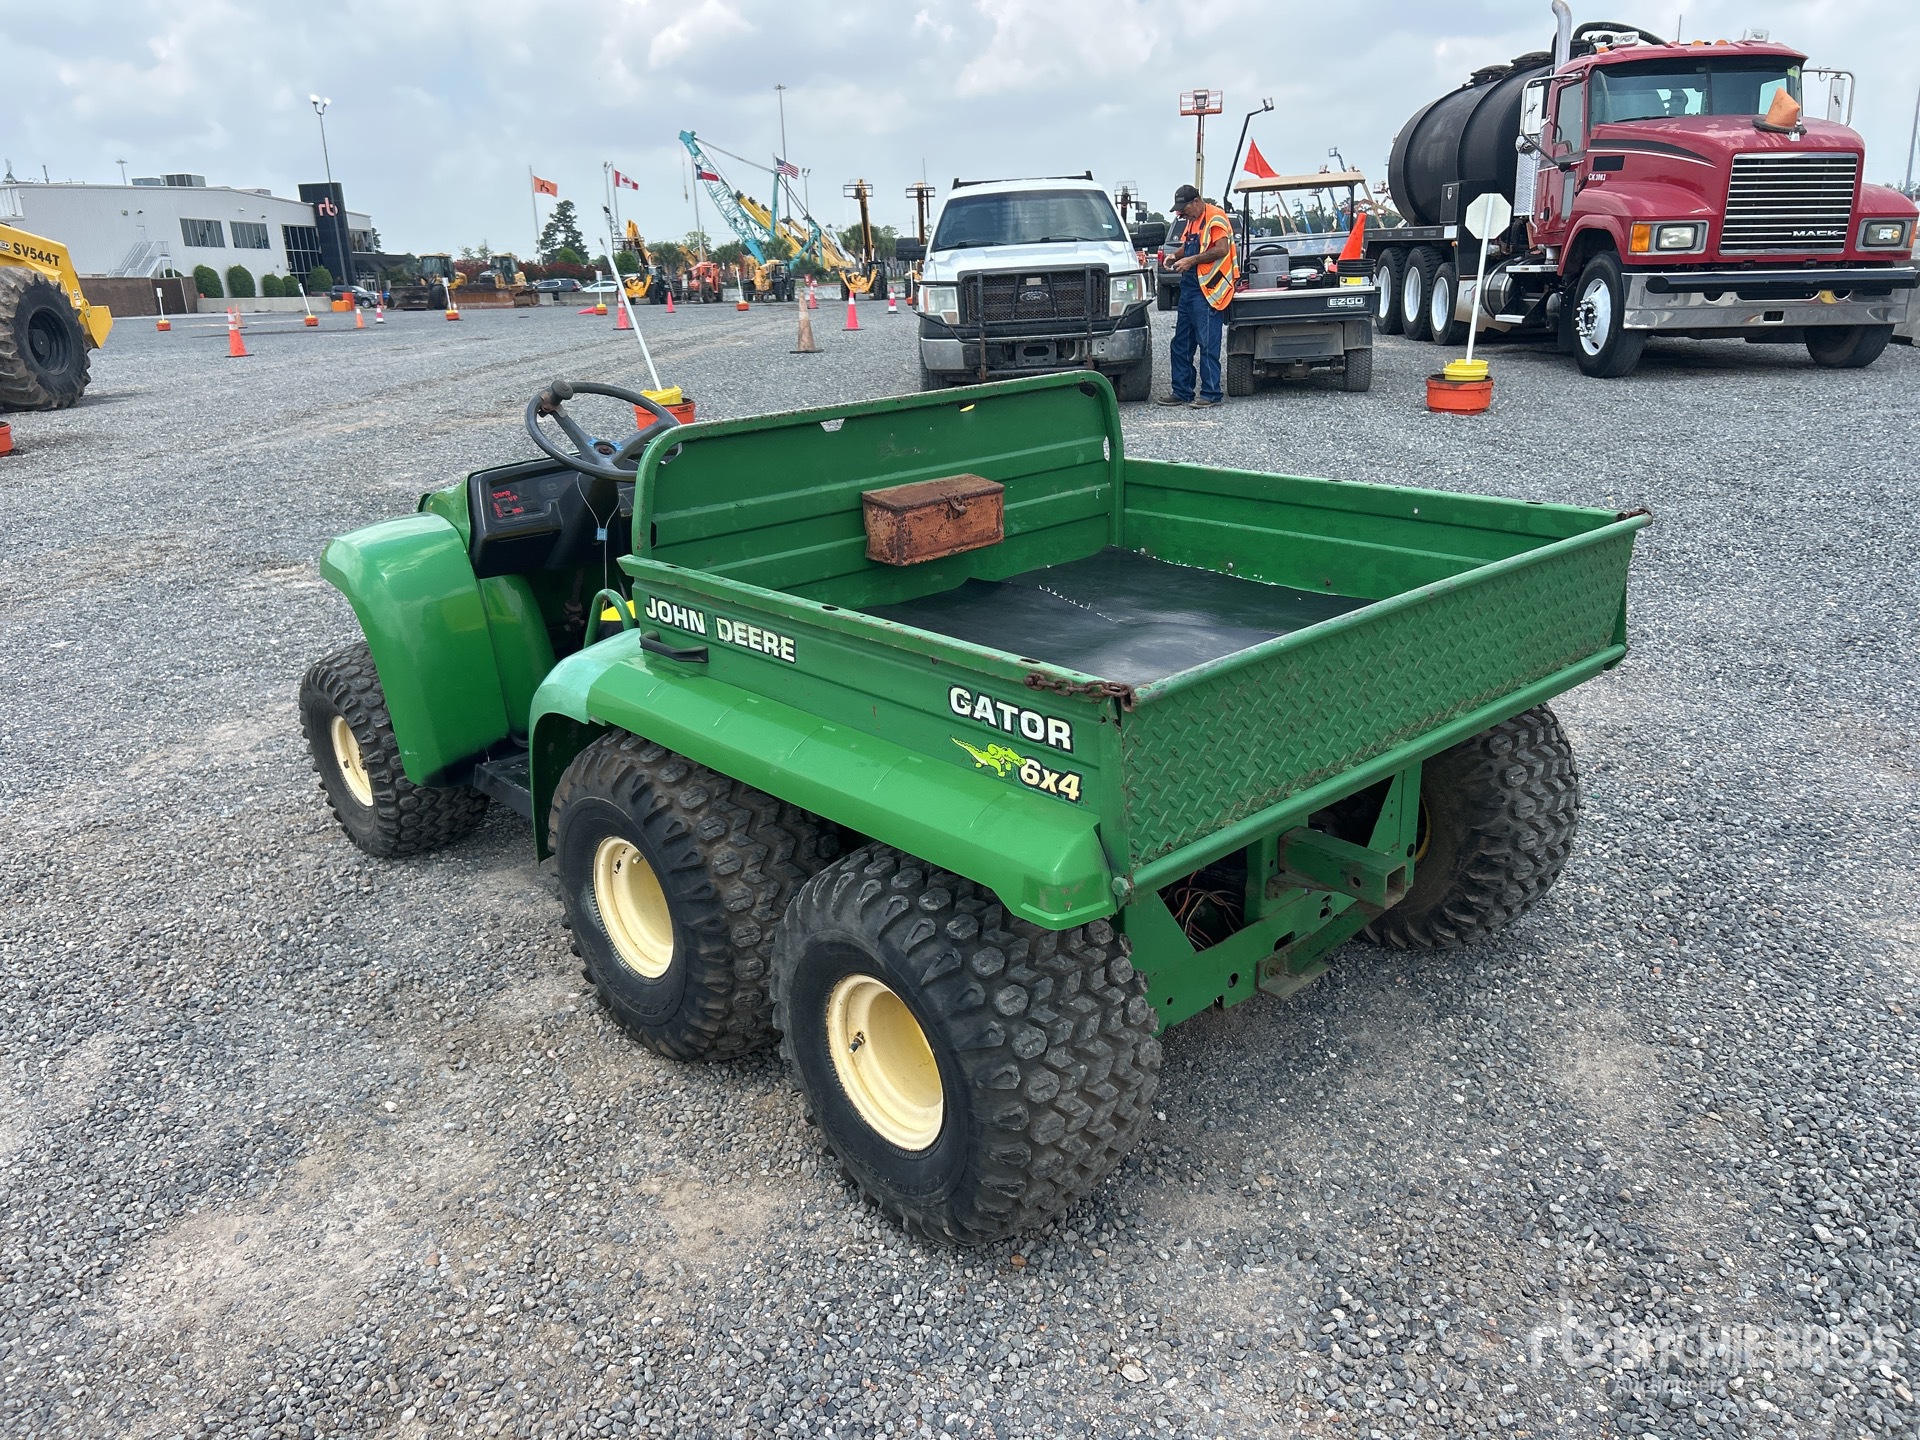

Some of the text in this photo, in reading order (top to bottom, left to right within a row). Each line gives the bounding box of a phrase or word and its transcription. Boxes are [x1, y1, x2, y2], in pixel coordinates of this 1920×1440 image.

[318, 197, 339, 217] rb
[13, 242, 60, 266] SV544T
[645, 596, 796, 664] JOHN DEERE
[949, 687, 1072, 751] GATOR
[1020, 757, 1081, 802] 6x4
